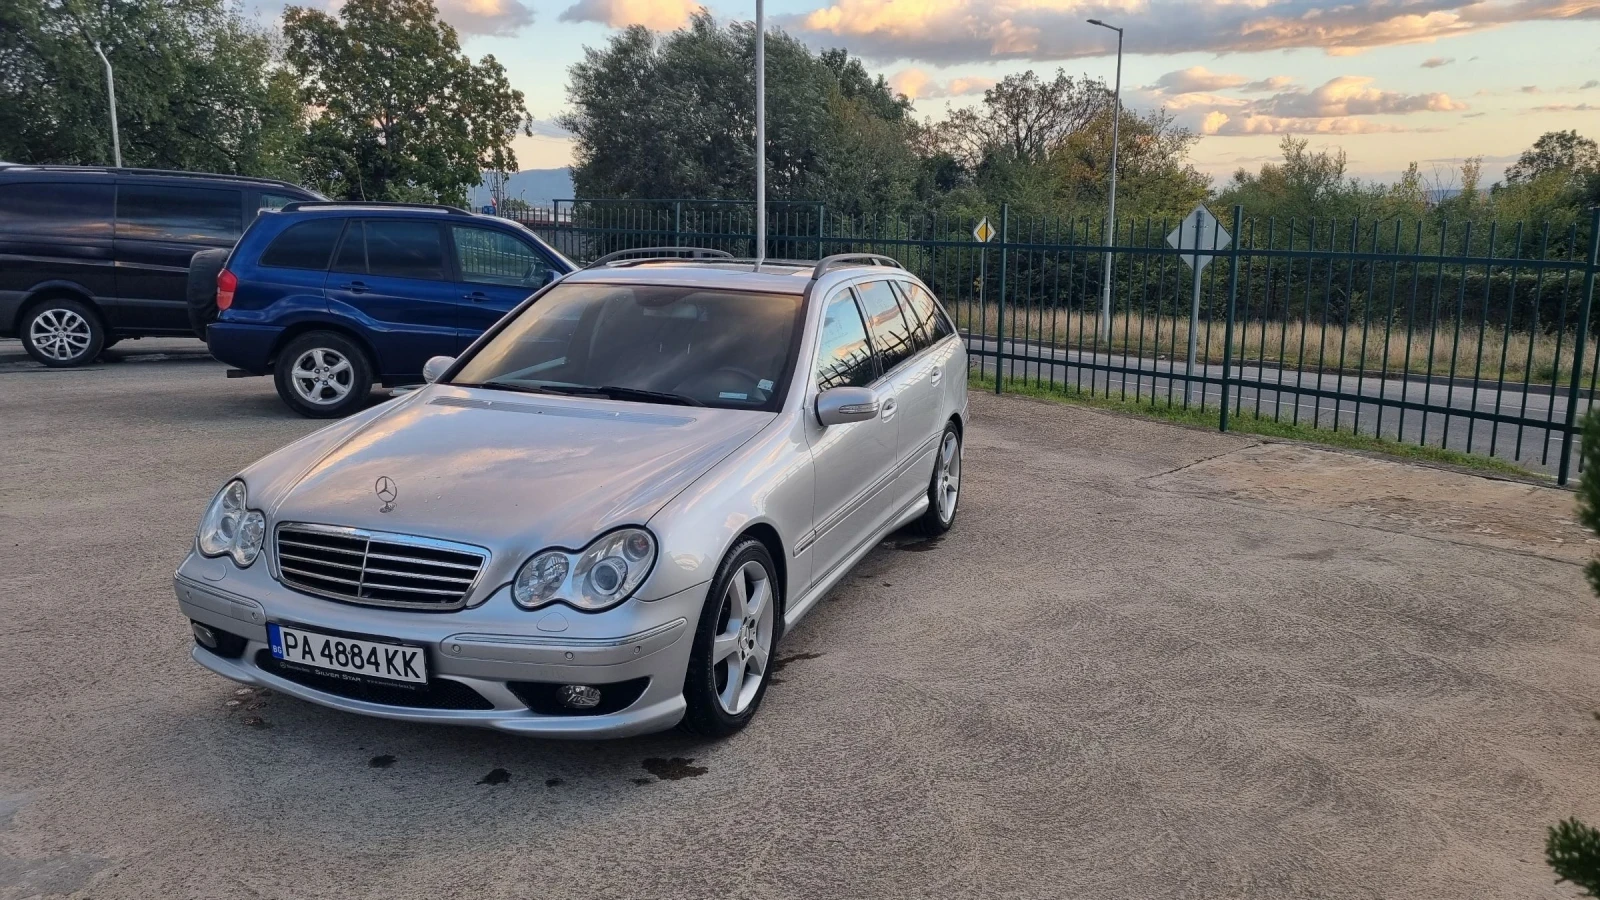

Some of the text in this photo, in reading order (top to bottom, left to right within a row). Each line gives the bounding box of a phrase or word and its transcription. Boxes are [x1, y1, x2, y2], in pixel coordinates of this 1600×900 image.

[273, 644, 283, 655] BG
[283, 631, 421, 679] PA 4884 KK
